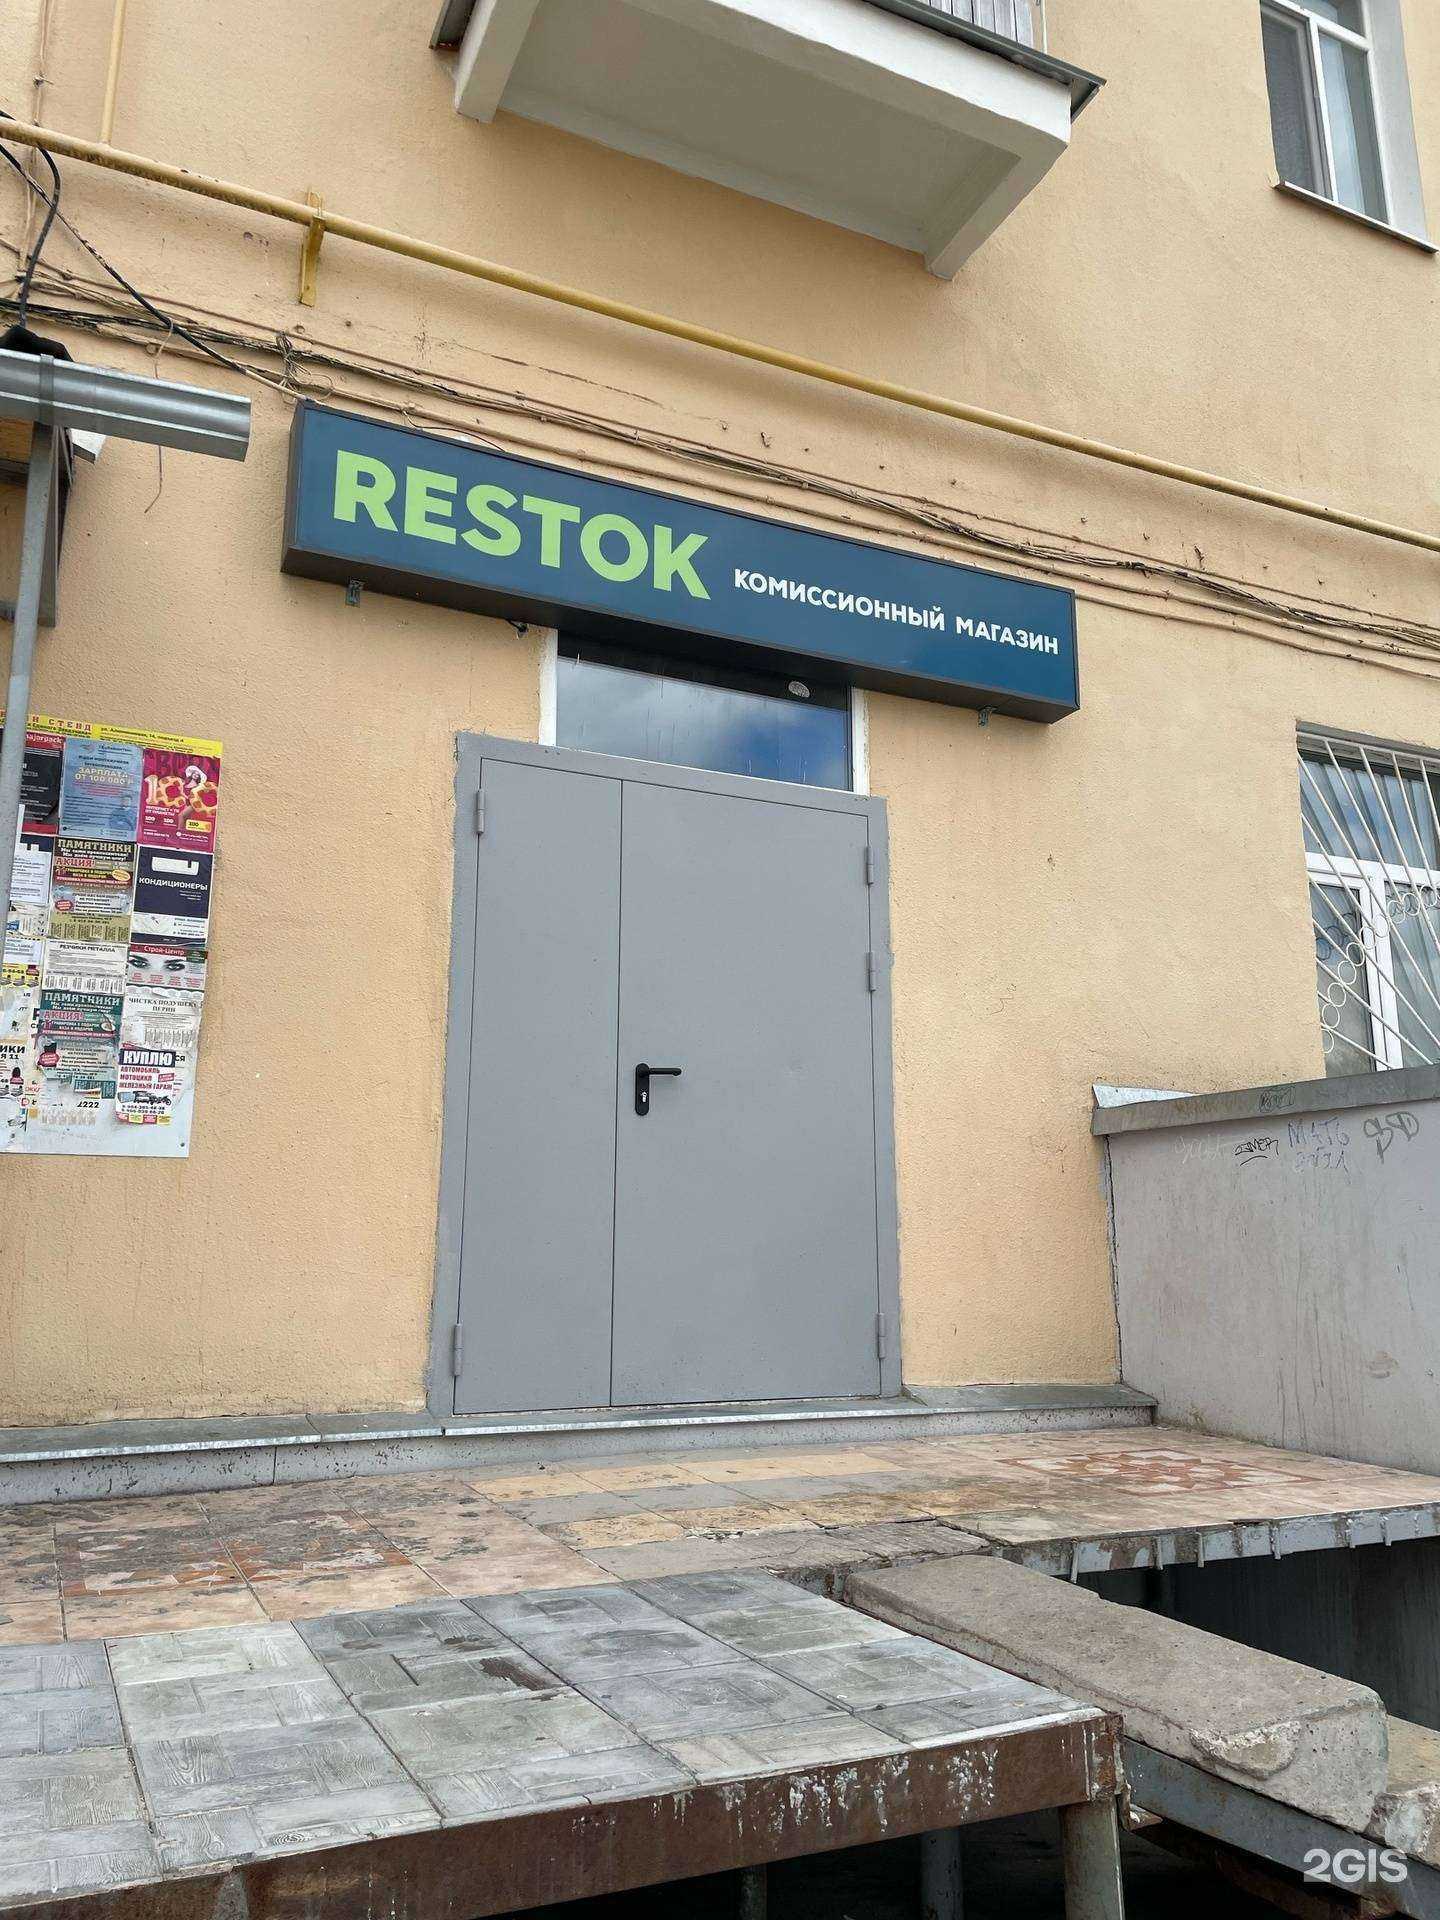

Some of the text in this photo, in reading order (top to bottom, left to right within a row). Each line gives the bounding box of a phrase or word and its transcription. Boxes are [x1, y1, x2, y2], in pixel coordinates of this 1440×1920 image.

[333, 450, 711, 601] RESTOK
[733, 567, 1060, 655] КОМИССИОННЫЙ МАГАЗИН
[57, 839, 132, 853] ПАМЯТНИКИ
[138, 877, 208, 891] КОНДИЦИОНЕРЫ
[143, 946, 185, 956] Строй-Центр
[45, 992, 121, 1006] ПАМЯТНИКИ
[123, 1050, 173, 1066] КУПЛЮ
[120, 1065, 160, 1074] АВТОМОБИЛЬ
[119, 1073, 152, 1081] МОТОЦИКЛ
